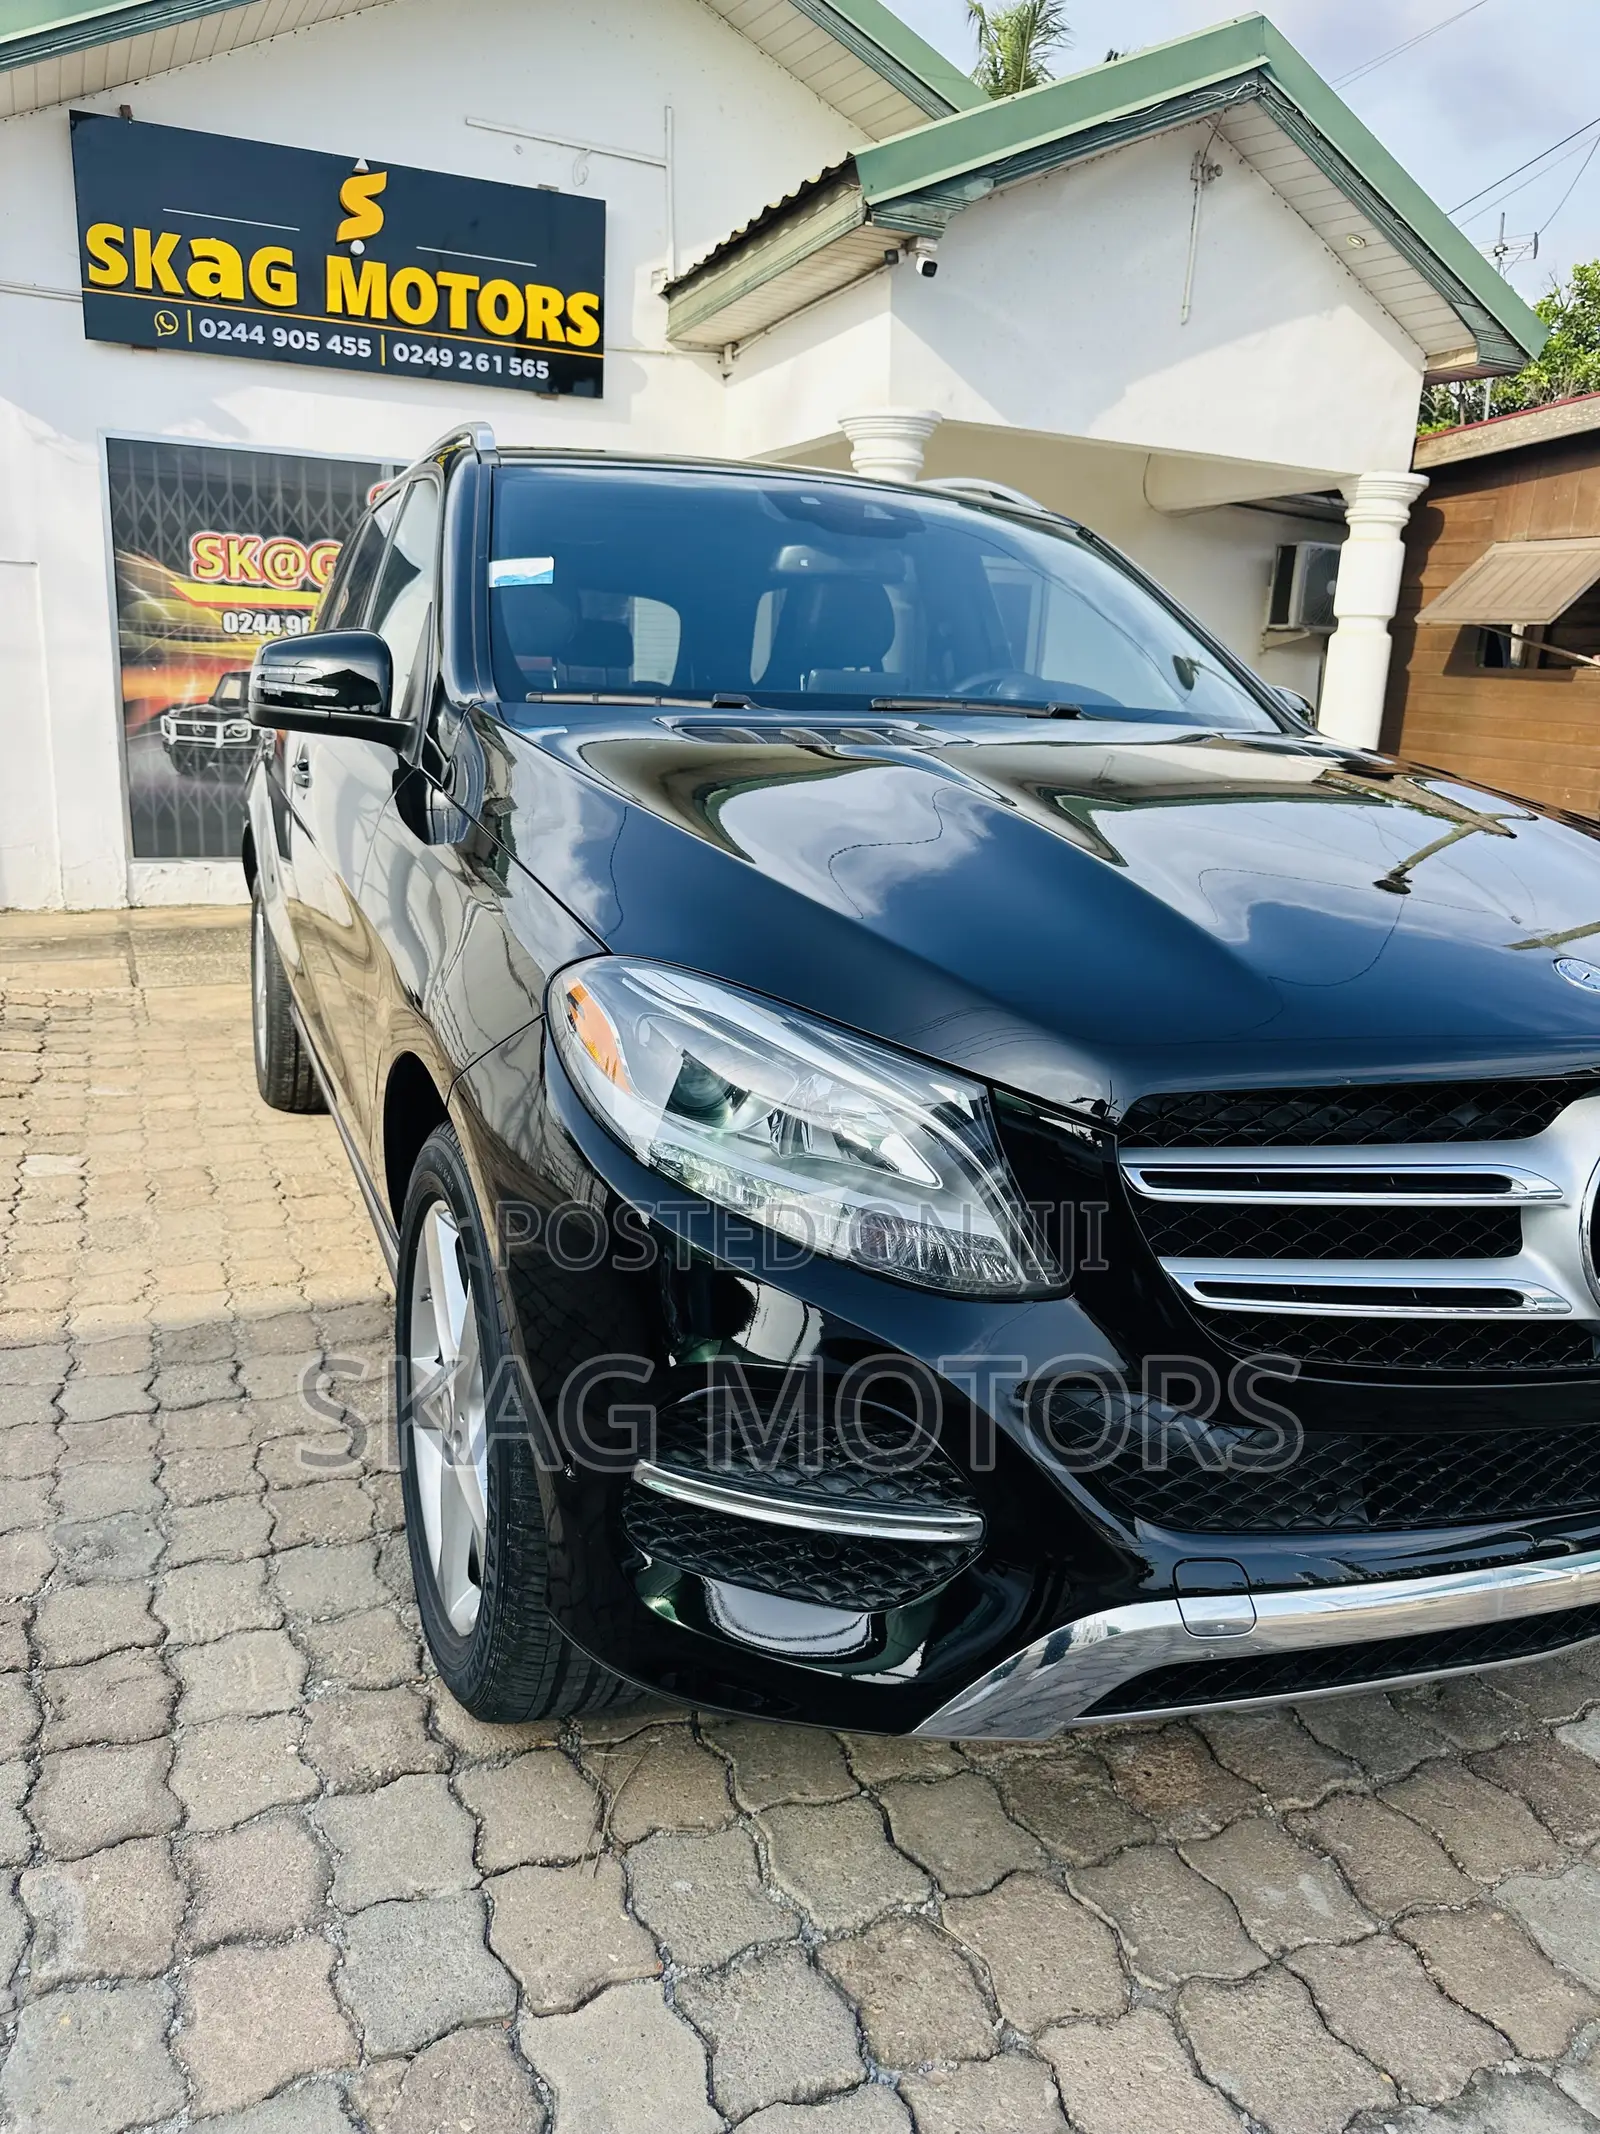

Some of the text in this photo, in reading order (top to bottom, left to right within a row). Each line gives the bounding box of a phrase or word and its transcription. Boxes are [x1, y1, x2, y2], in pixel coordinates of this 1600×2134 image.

[326, 254, 601, 347] MOTORS
[199, 318, 550, 380] 0244 905 455 0249 261 565
[222, 611, 283, 636] 0244
